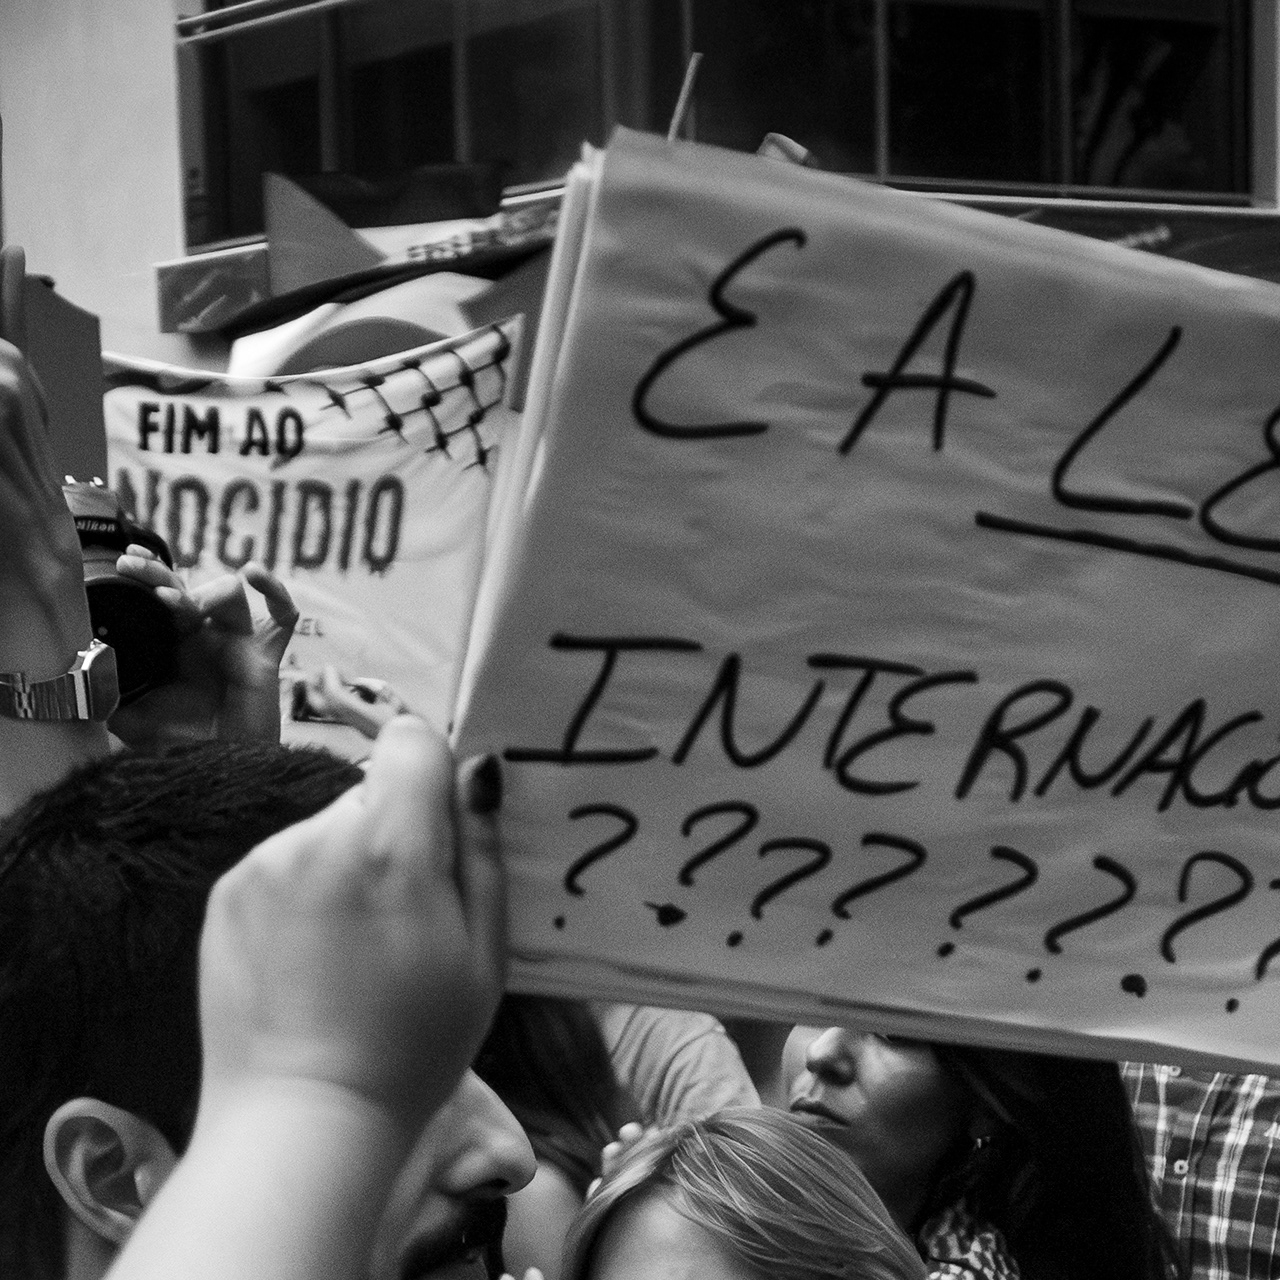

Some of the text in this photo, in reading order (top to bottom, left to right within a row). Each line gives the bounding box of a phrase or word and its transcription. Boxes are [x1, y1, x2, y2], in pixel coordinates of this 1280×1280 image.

[632, 230, 806, 440] E
[836, 270, 997, 456] A
[139, 402, 306, 458] FIM AO
